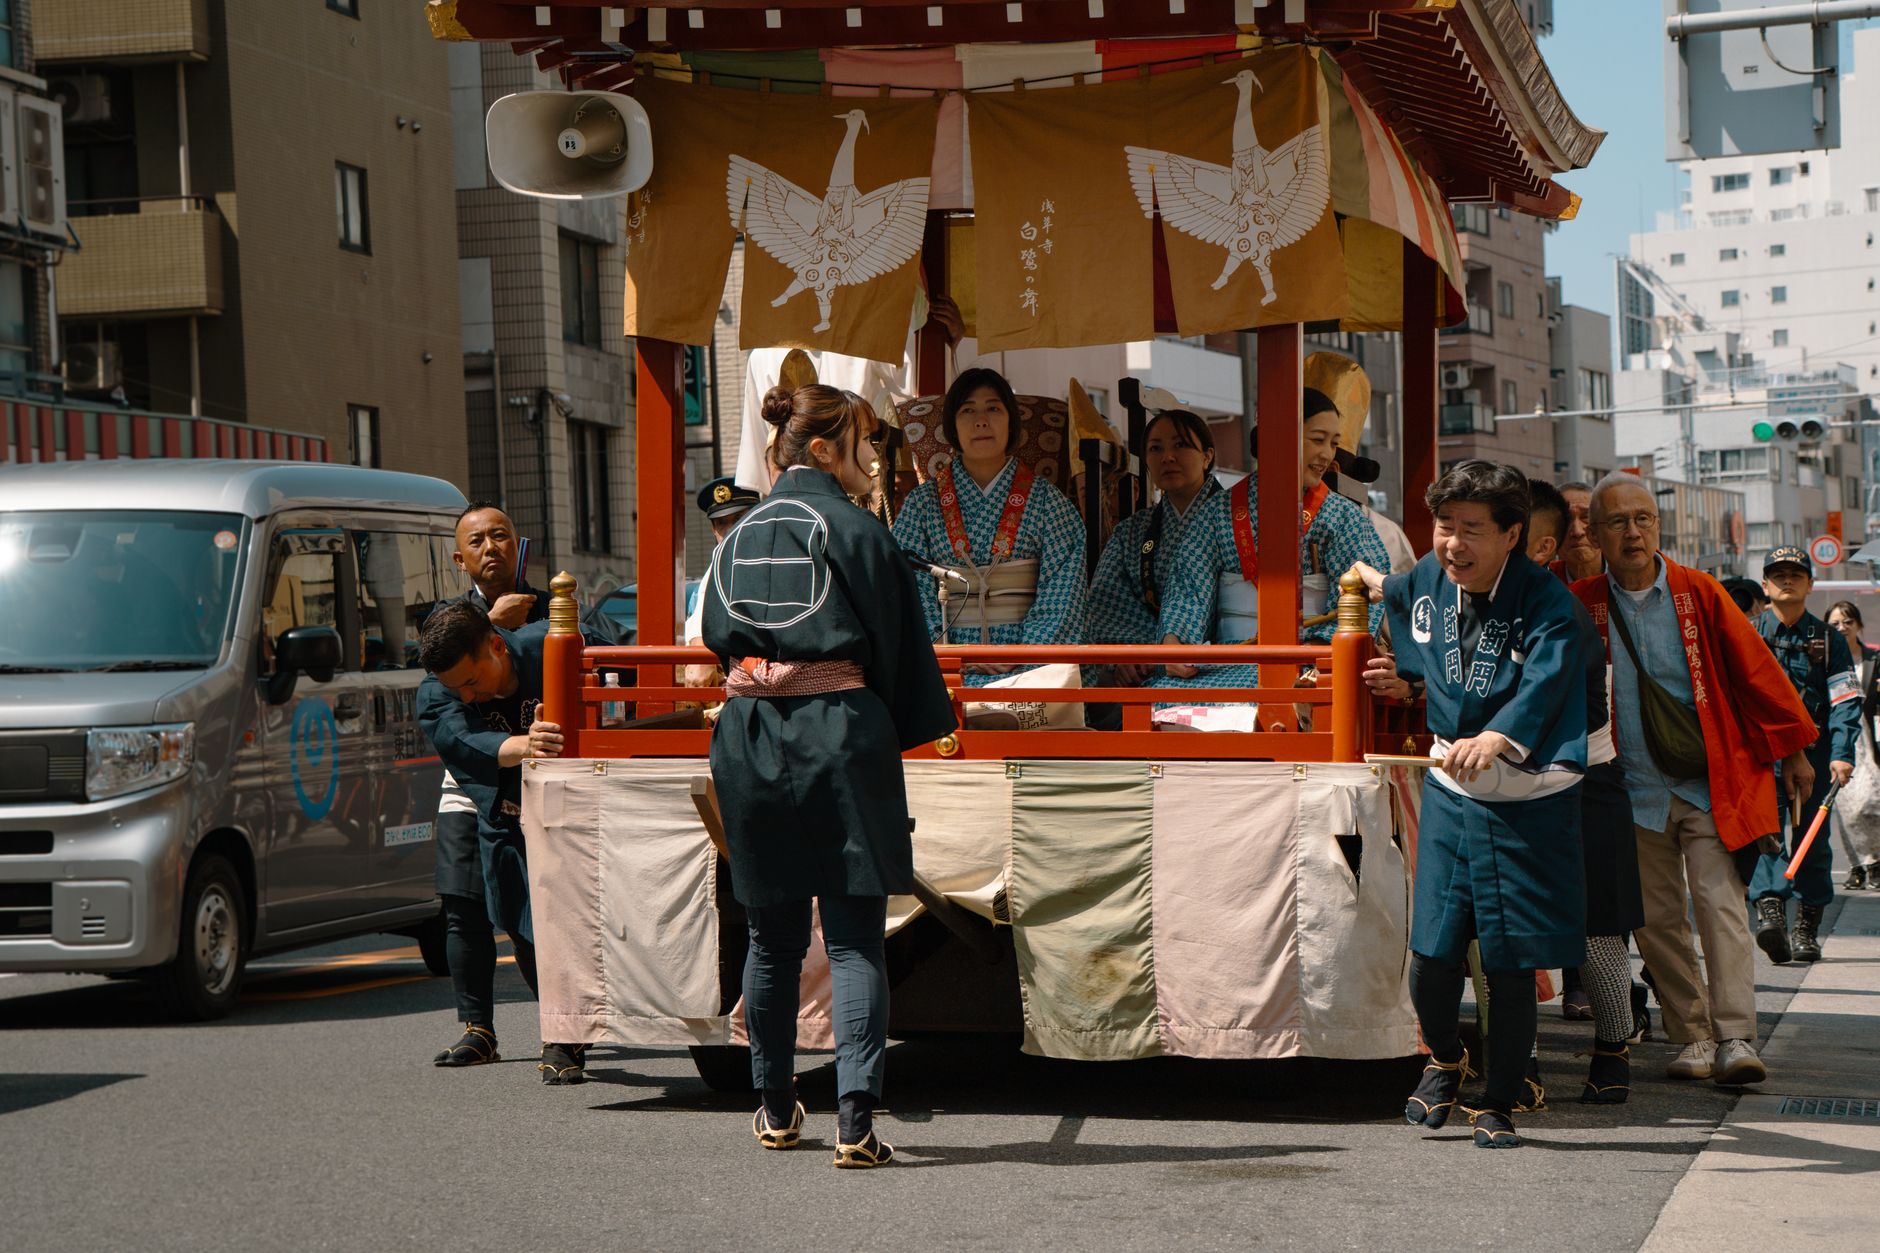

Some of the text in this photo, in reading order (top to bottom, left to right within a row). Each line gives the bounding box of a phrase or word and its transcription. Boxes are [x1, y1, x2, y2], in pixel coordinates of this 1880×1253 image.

[1038, 198, 1055, 255] 浅草寺
[1019, 221, 1039, 317] 白鷺の舞
[1770, 547, 1805, 559] TOKYO
[1817, 544, 1836, 558] 40
[1443, 605, 1462, 684] 新門
[1465, 619, 1510, 698] 新門
[1684, 618, 1708, 708] 白鷺の舞
